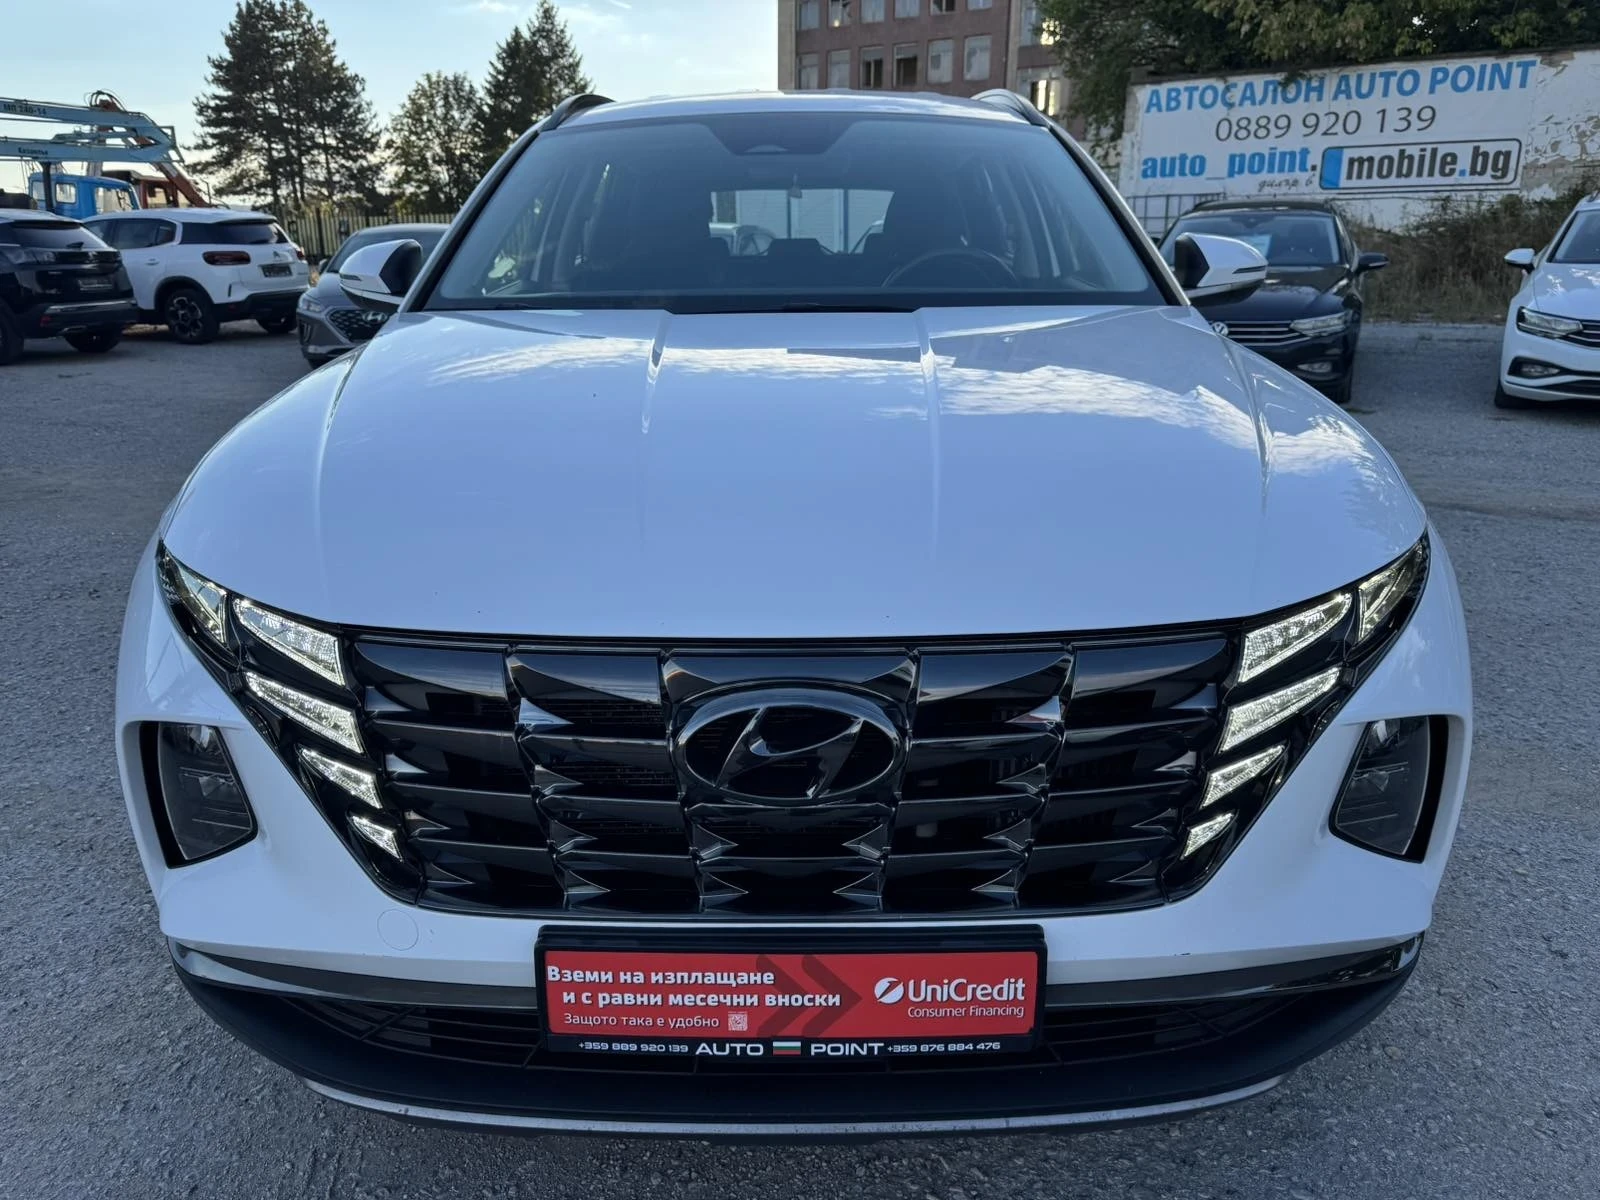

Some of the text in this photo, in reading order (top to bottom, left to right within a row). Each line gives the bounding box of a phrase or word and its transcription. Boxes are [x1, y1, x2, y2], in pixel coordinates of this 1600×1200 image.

[1144, 60, 1537, 114] АВТОСАЛОН AUTO POINT
[1215, 105, 1437, 142] 0889 920 139
[1346, 145, 1512, 180] mobile.bg
[547, 965, 775, 987] Вземи на изплащане
[563, 991, 841, 1008] и с равни месечни вноски
[908, 978, 1025, 1003] UniCredit
[564, 1012, 720, 1030] Защото така е удобно
[908, 1005, 1025, 1019] Consumer Financing
[579, 1041, 689, 1053] +359 889 920 139
[695, 1043, 884, 1056] AUTO POINT
[887, 1044, 917, 1053] +359
[976, 1042, 1001, 1050] 476
